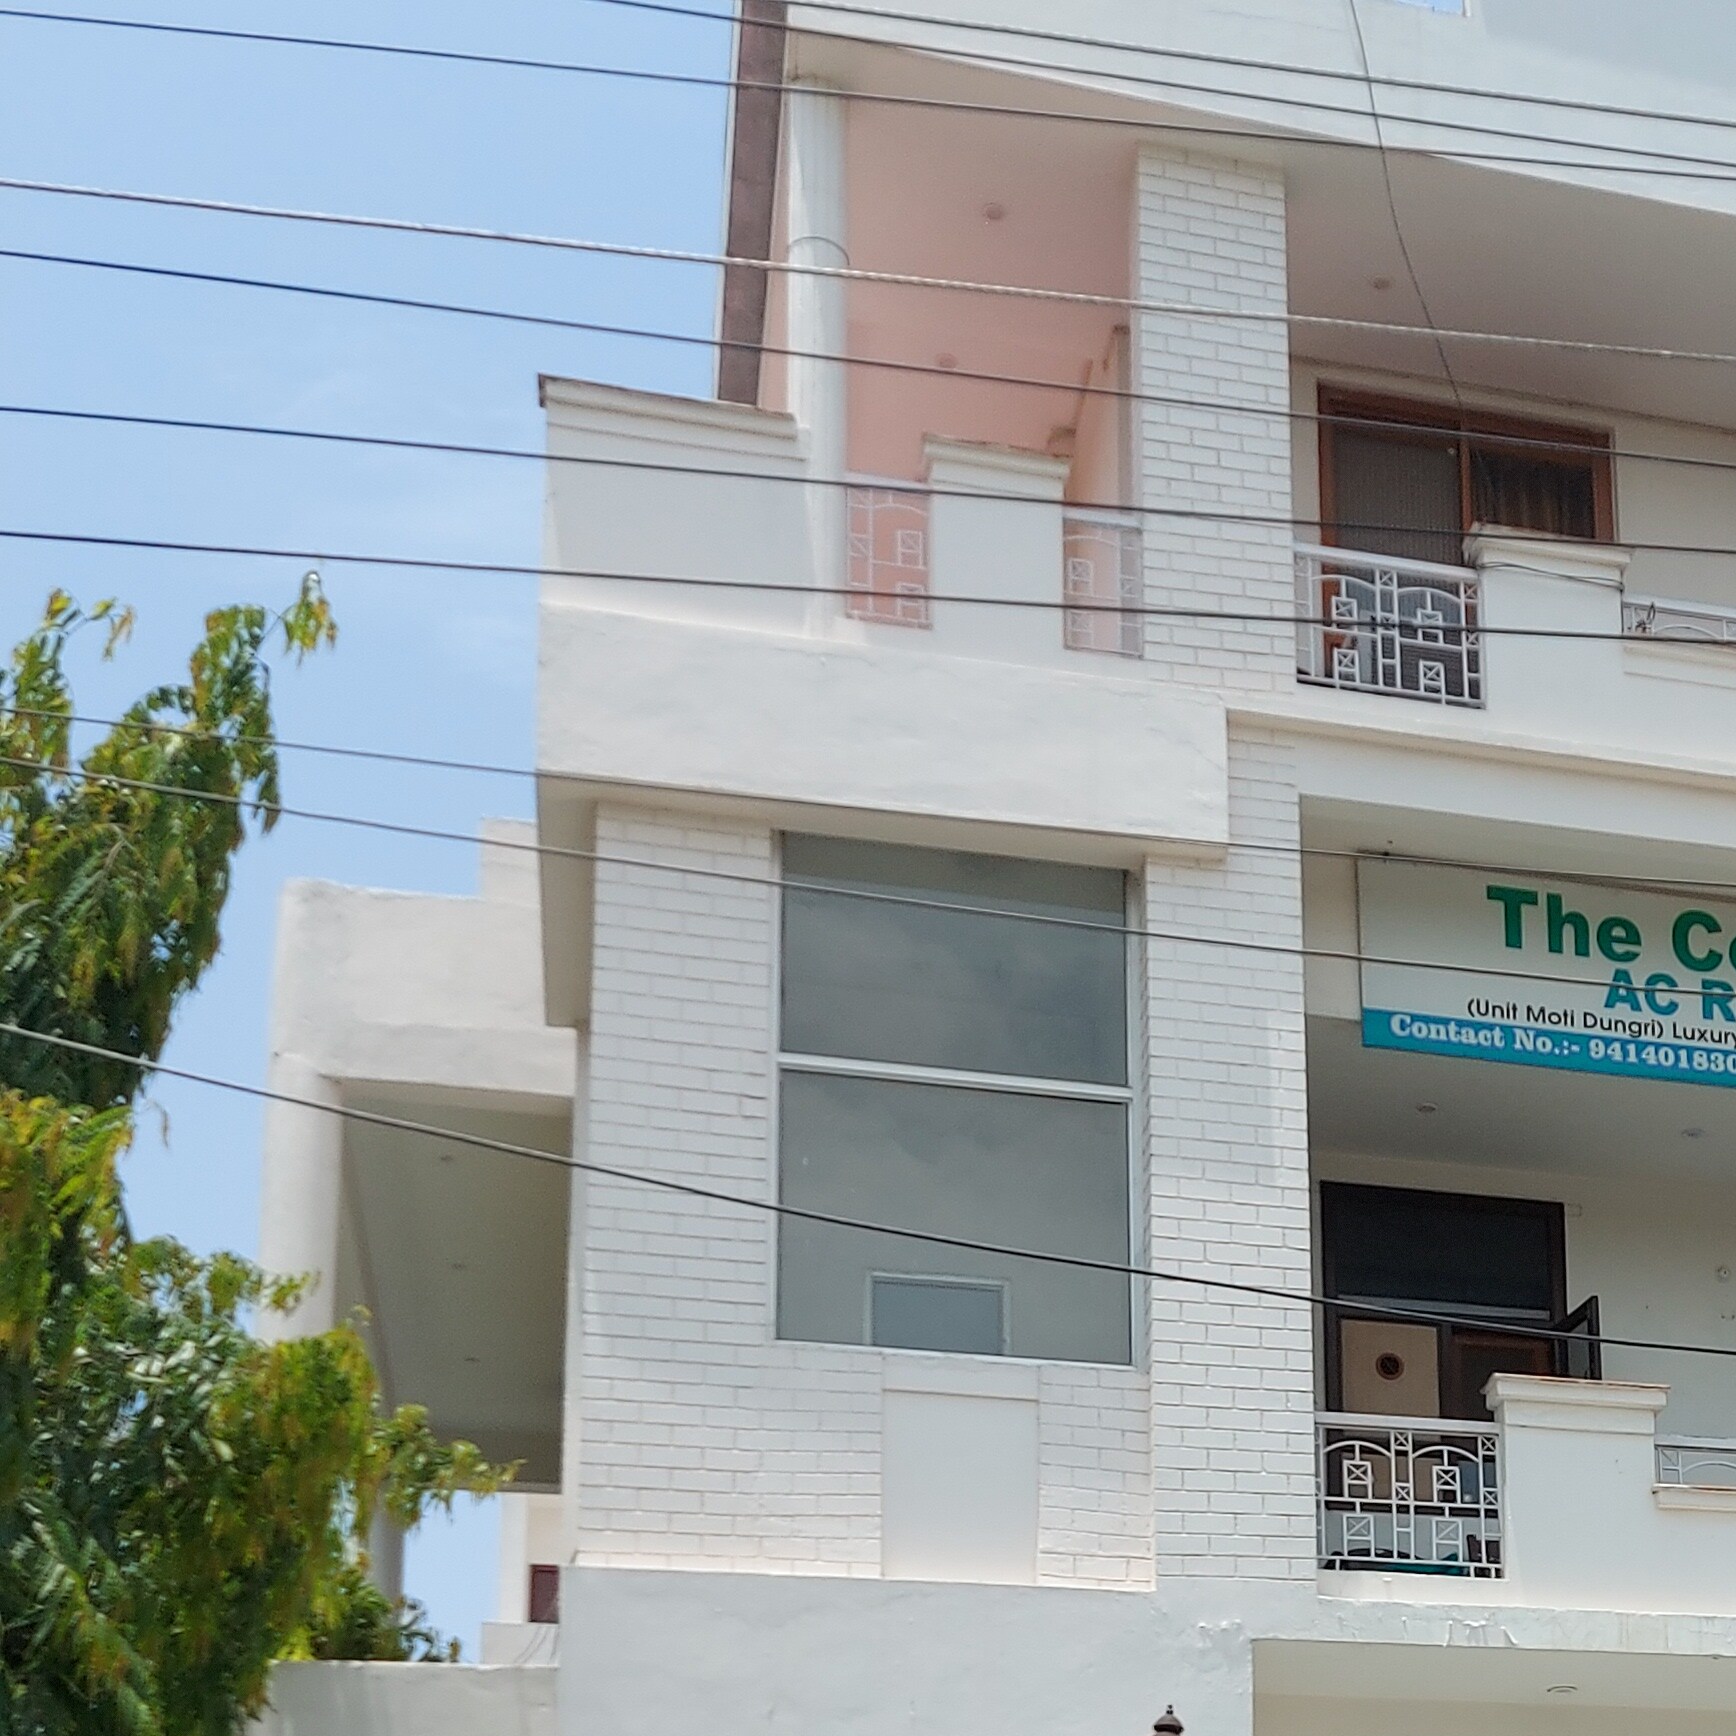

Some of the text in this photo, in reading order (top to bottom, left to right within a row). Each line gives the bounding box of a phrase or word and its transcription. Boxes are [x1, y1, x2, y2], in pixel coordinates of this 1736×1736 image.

[1486, 884, 1643, 963] The
[1603, 967, 1680, 1016] AC
[1389, 1013, 1505, 1049] Contact
[1466, 998, 1518, 1019] (Unit
[1525, 1006, 1576, 1028] Moti
[1582, 1012, 1664, 1039] Dungri)
